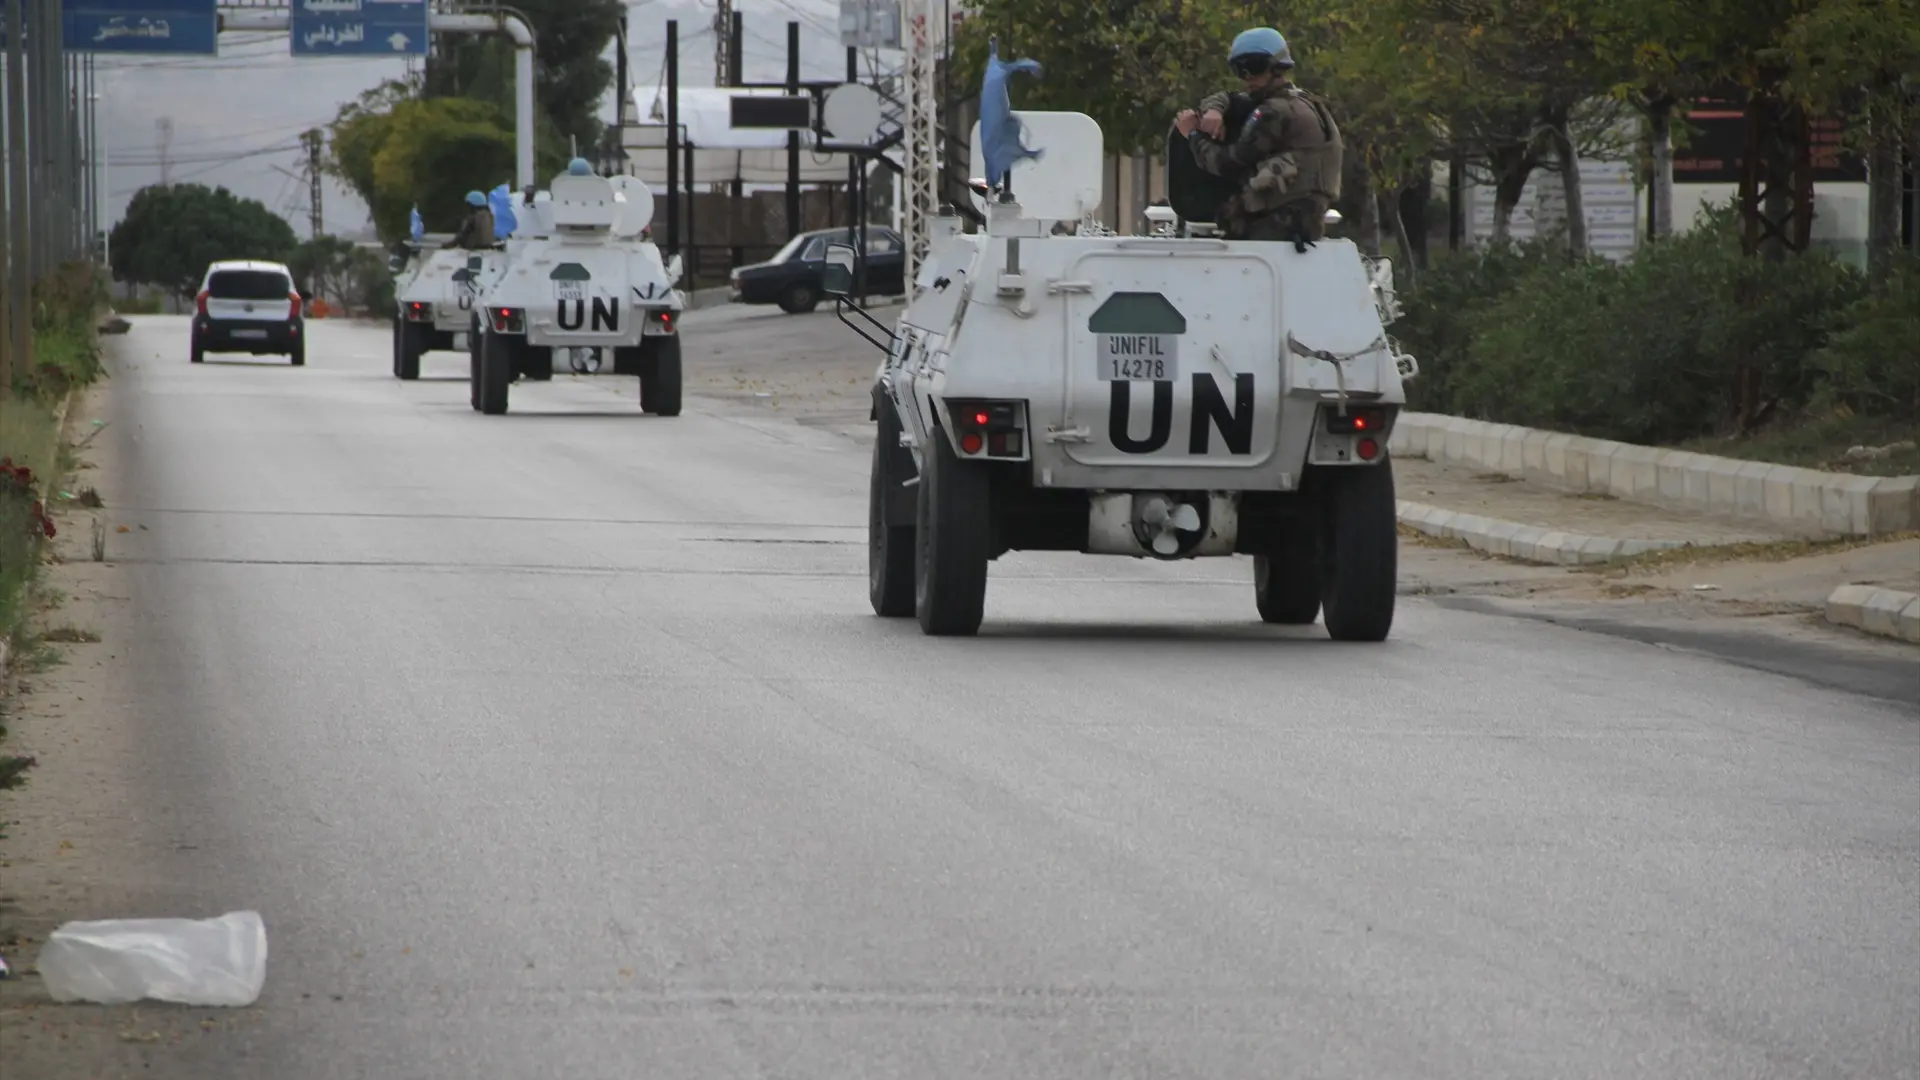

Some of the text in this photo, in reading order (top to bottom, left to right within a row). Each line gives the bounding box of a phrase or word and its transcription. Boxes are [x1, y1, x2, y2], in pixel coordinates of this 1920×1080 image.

[557, 297, 619, 332] UN
[1110, 335, 1165, 356] UNIFIL
[1112, 359, 1165, 379] 14278
[1108, 372, 1255, 455] UN
